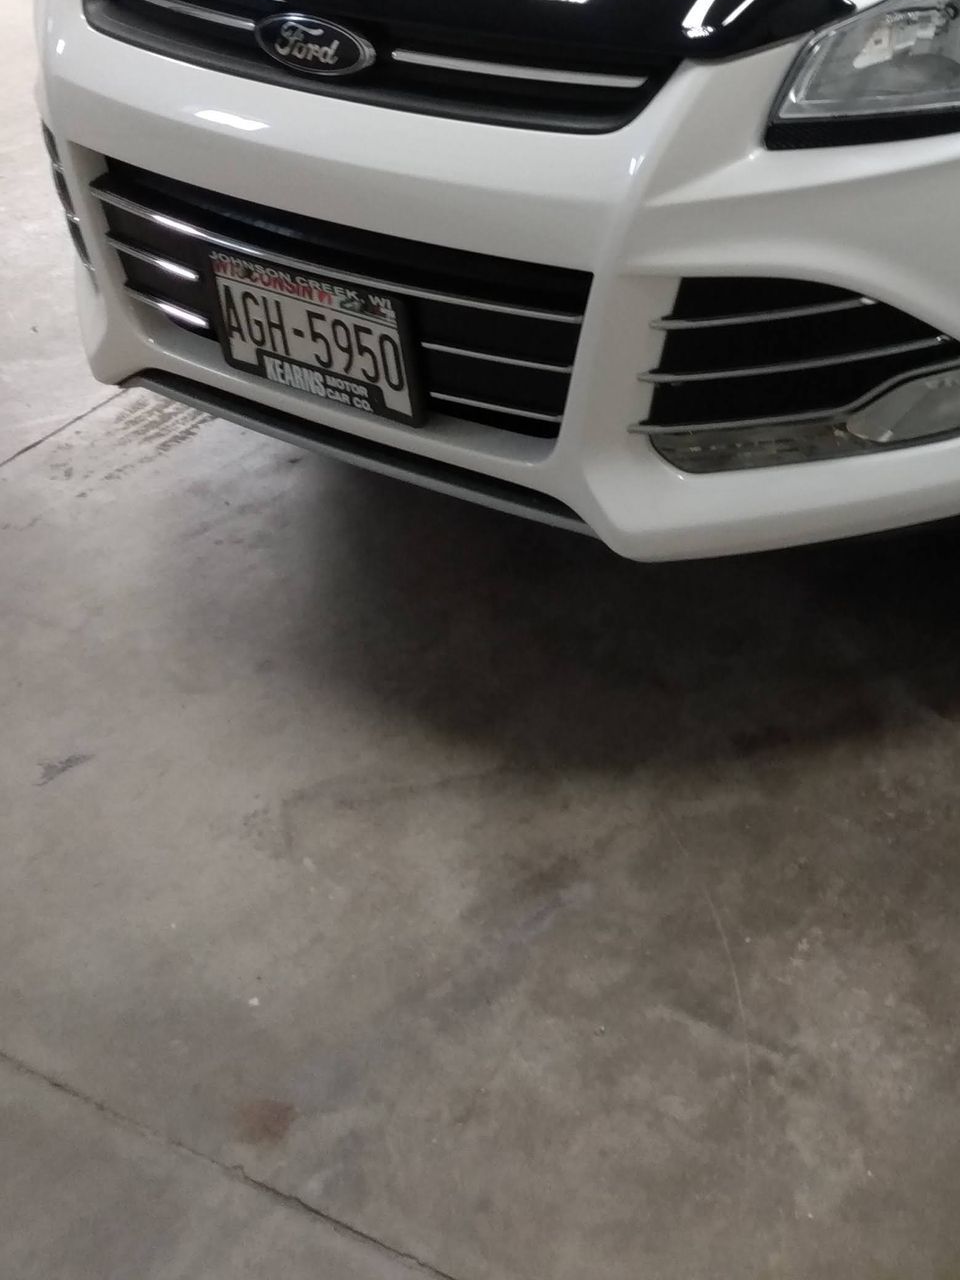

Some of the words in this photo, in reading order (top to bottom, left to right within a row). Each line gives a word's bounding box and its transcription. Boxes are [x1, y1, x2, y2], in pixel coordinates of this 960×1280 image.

[274, 21, 340, 65] Ford
[208, 250, 292, 283] JOHNSON
[368, 294, 392, 310] WI
[223, 284, 404, 392] AGH-5950
[263, 355, 326, 397] KEARNS
[325, 375, 369, 399] MOTOR
[326, 388, 351, 405] CAR
